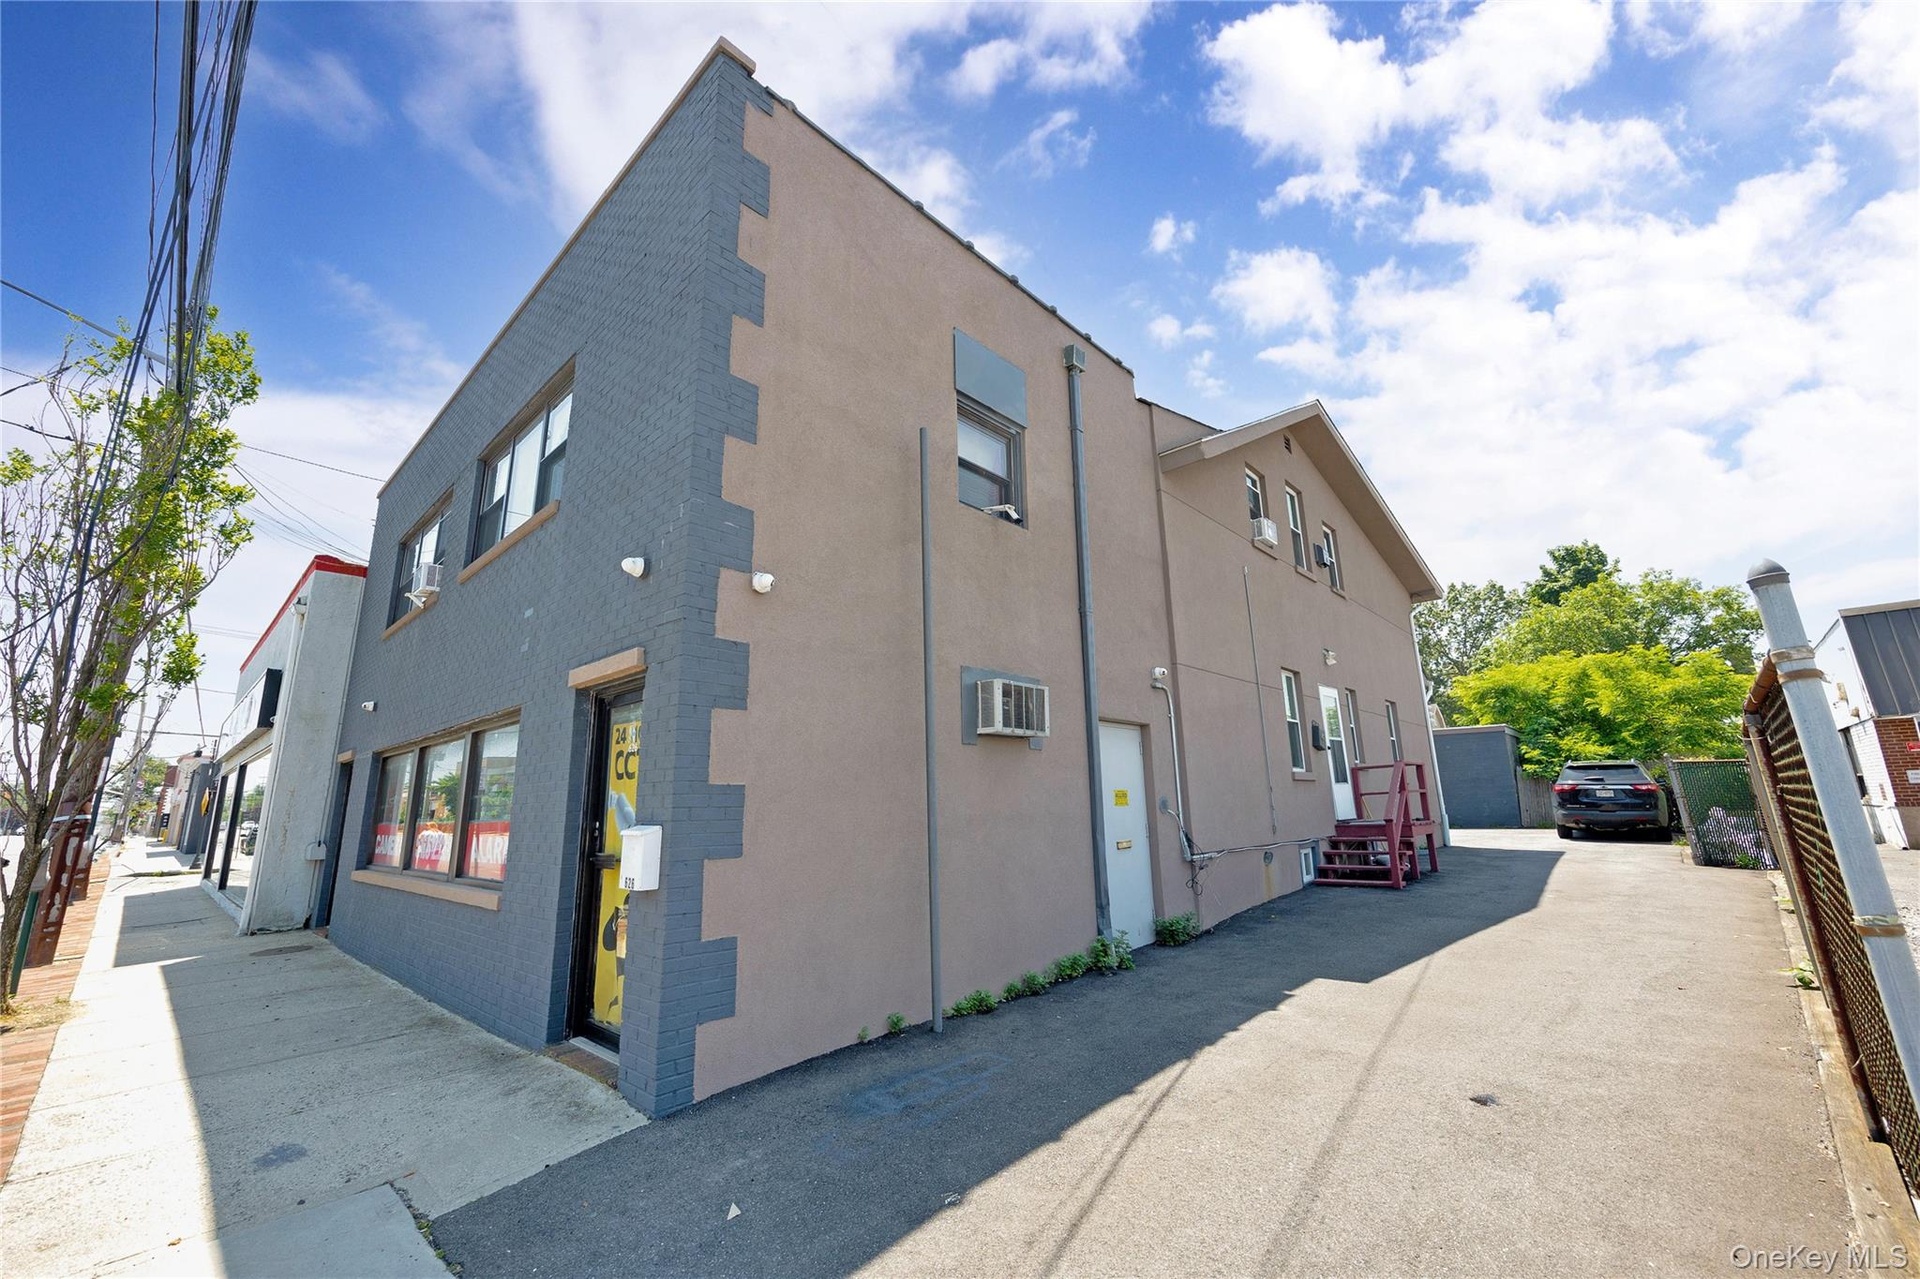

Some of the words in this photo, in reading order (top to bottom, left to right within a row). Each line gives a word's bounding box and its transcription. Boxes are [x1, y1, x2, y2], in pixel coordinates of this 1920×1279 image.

[615, 727, 627, 744] 24
[615, 749, 640, 780] CC
[624, 876, 635, 889] 626
